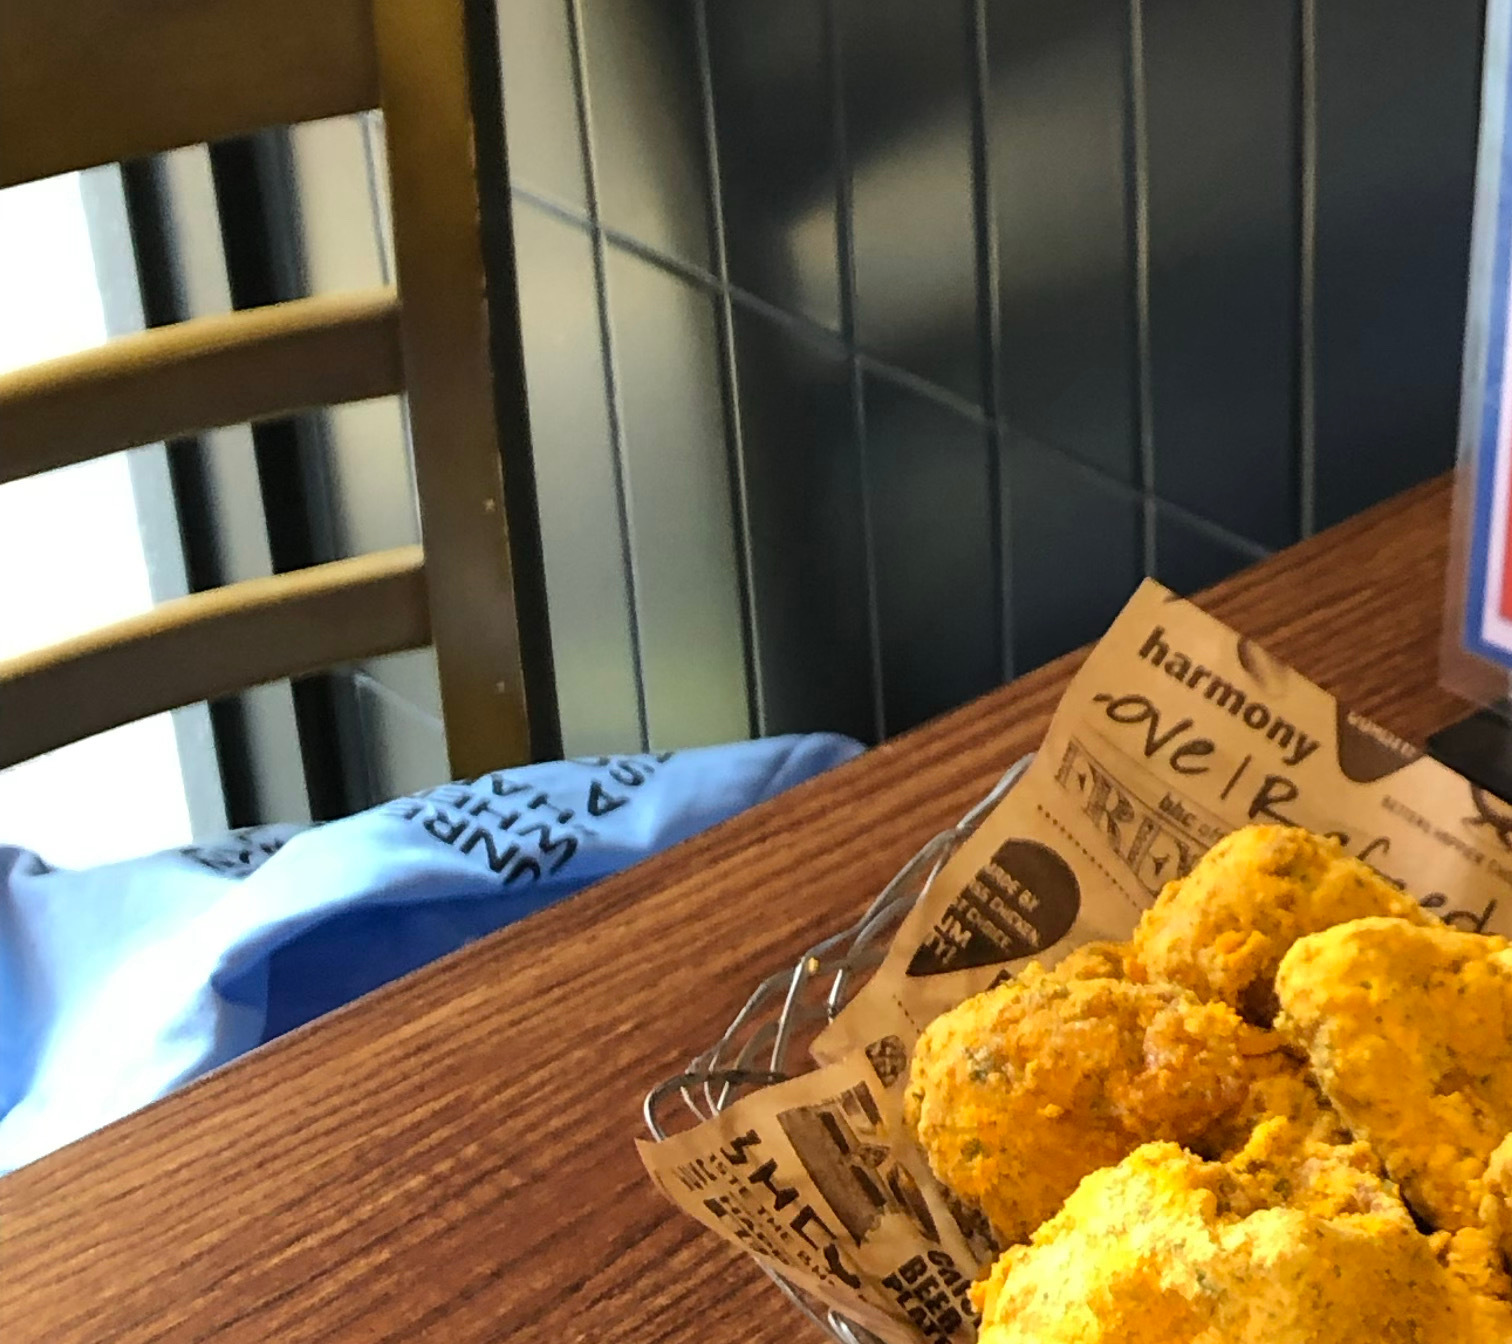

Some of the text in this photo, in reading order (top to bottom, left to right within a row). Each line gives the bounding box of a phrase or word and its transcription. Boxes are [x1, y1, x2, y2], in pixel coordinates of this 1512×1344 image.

[1093, 692, 1216, 775] ove
[1138, 626, 1320, 766] harmony
[897, 1254, 963, 1335] BEER
